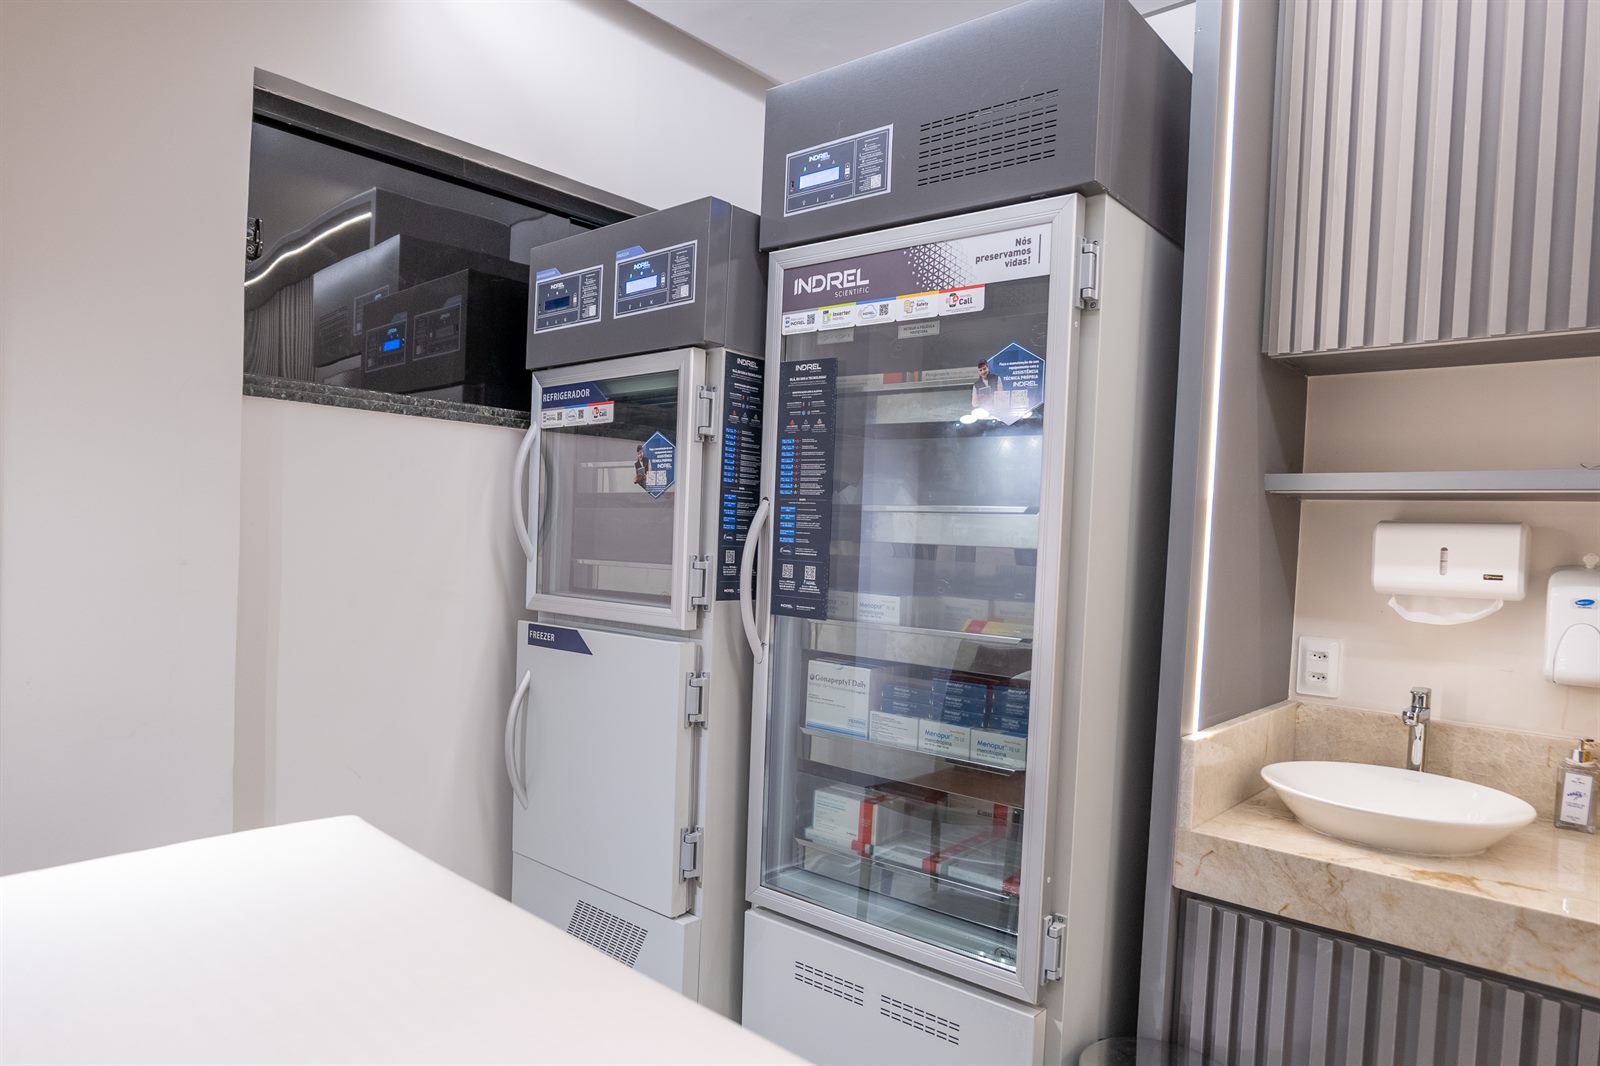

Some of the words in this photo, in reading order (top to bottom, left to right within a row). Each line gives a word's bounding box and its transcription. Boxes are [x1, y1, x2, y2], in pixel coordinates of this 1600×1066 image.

[1015, 236, 1032, 247] Nós
[975, 247, 1032, 264] preservamos
[1004, 256, 1031, 268] vidas!
[793, 267, 870, 296] INDREL
[834, 286, 870, 298] SCIENTIFIC
[958, 297, 973, 306] Call
[832, 309, 851, 317] Inverter
[542, 388, 590, 402] REFRIGERADOR
[529, 630, 555, 642] FREEZER
[815, 673, 850, 686] Gonapeptyl
[925, 729, 951, 740] Menopur
[977, 740, 1005, 751] Menopur
